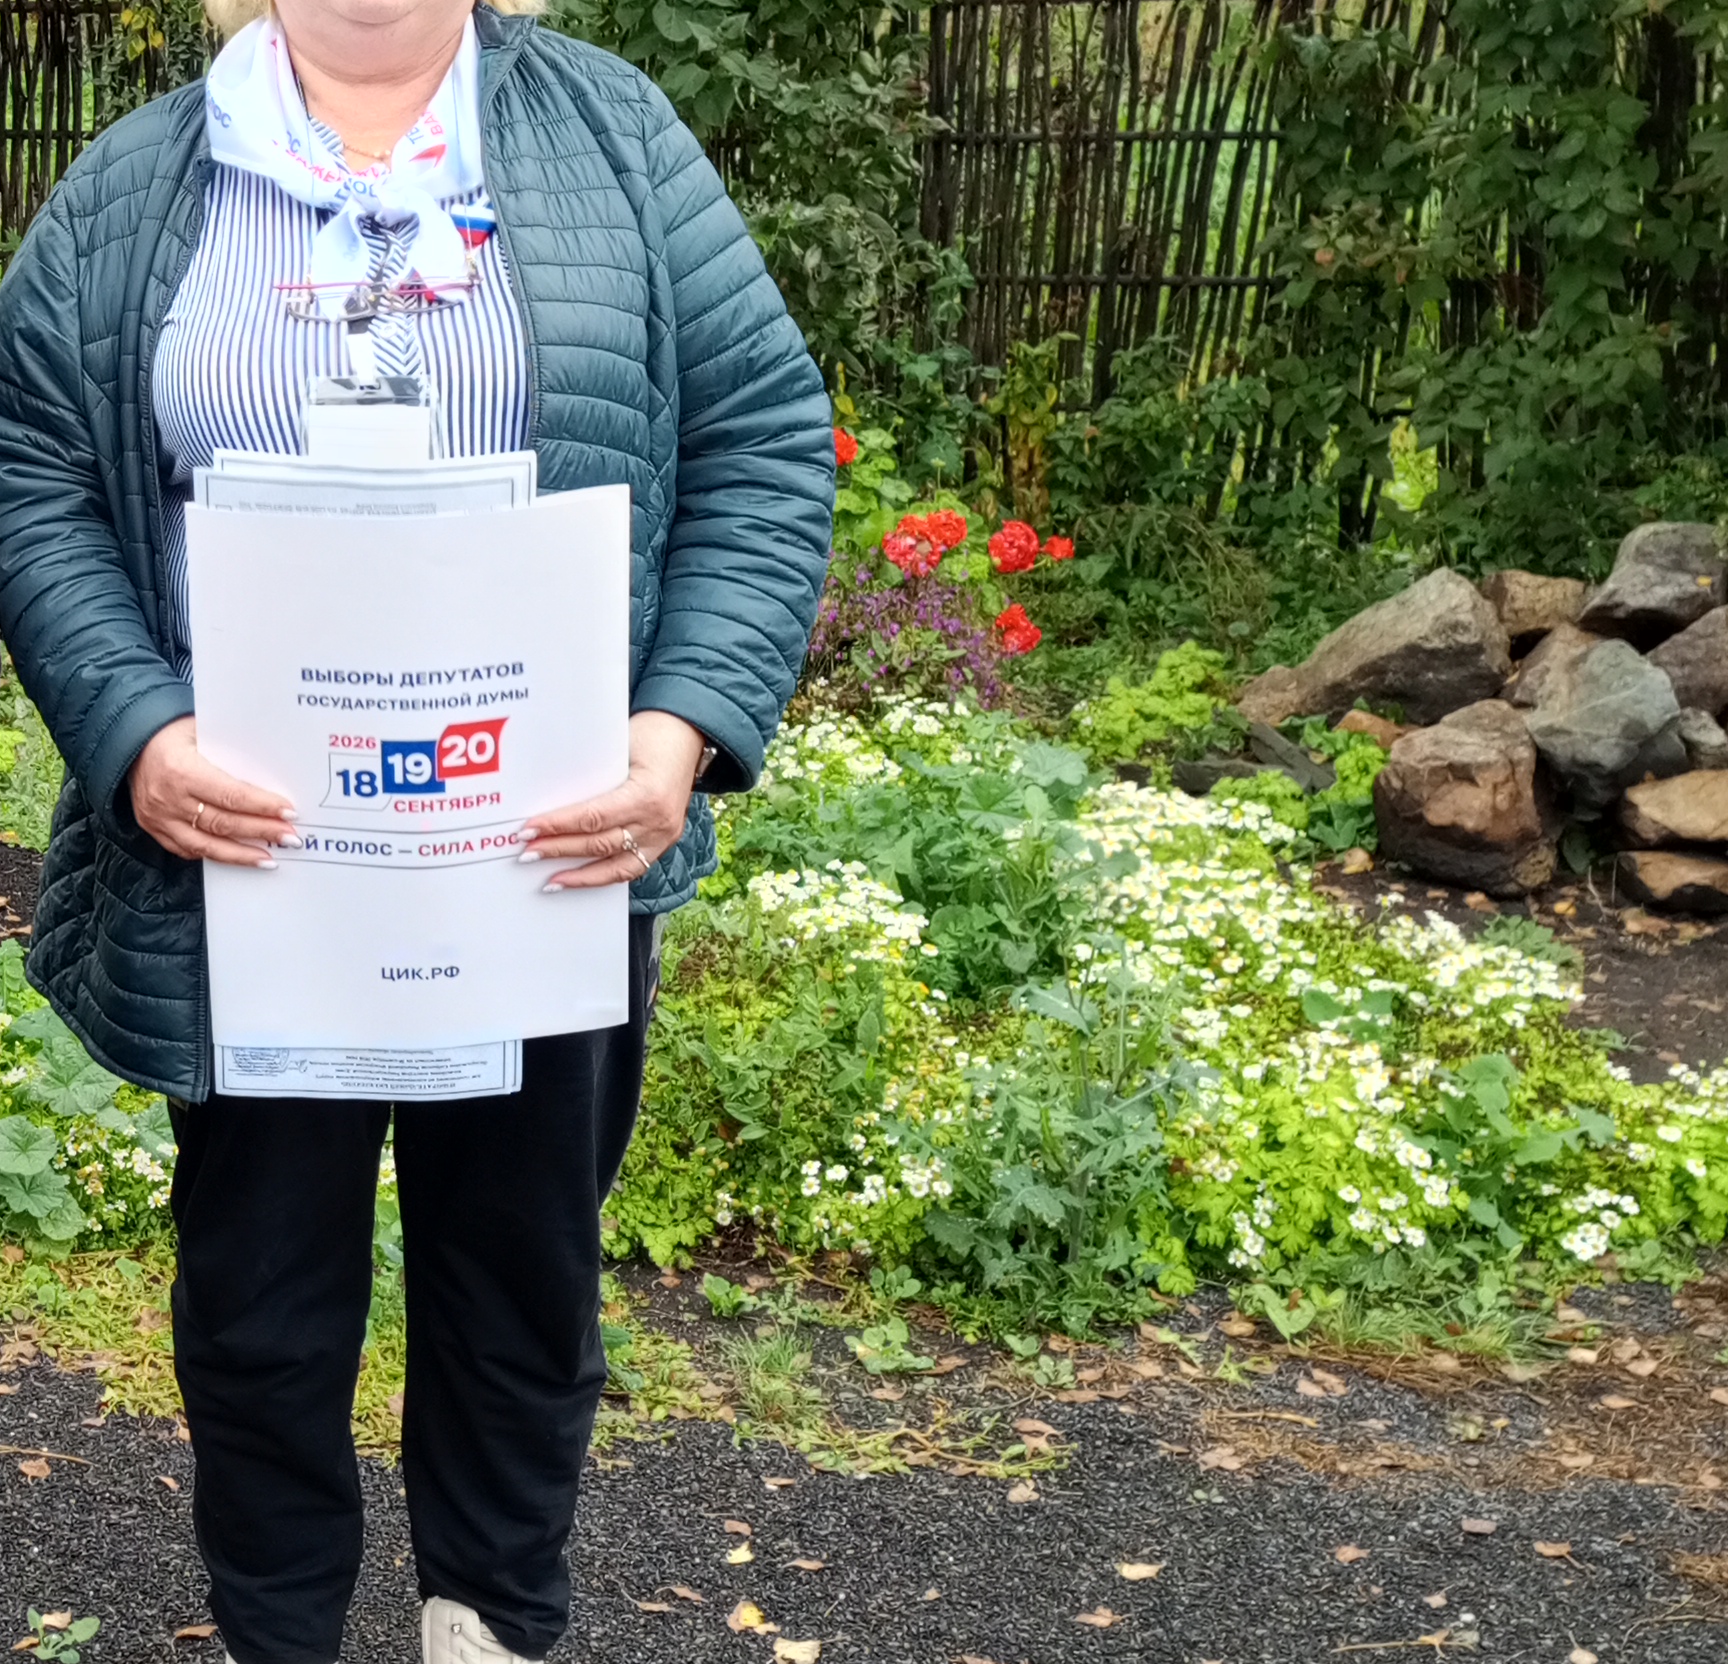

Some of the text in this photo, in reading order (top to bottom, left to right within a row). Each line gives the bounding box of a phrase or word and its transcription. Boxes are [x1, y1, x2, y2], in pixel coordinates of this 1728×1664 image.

[300, 661, 525, 688] ВЫБОРЫ ДЕПУТАТОВ
[297, 687, 530, 711] ГОСУДАРСТВЕННОЙ ДУМЫ
[328, 734, 377, 750] 2026
[335, 731, 496, 798] 18 19 20
[393, 792, 502, 813] СЕНТЯБРЯ
[324, 839, 393, 857] ГОЛОС
[418, 839, 475, 857] СИЛА
[381, 965, 461, 982] ЦИК.РФ
